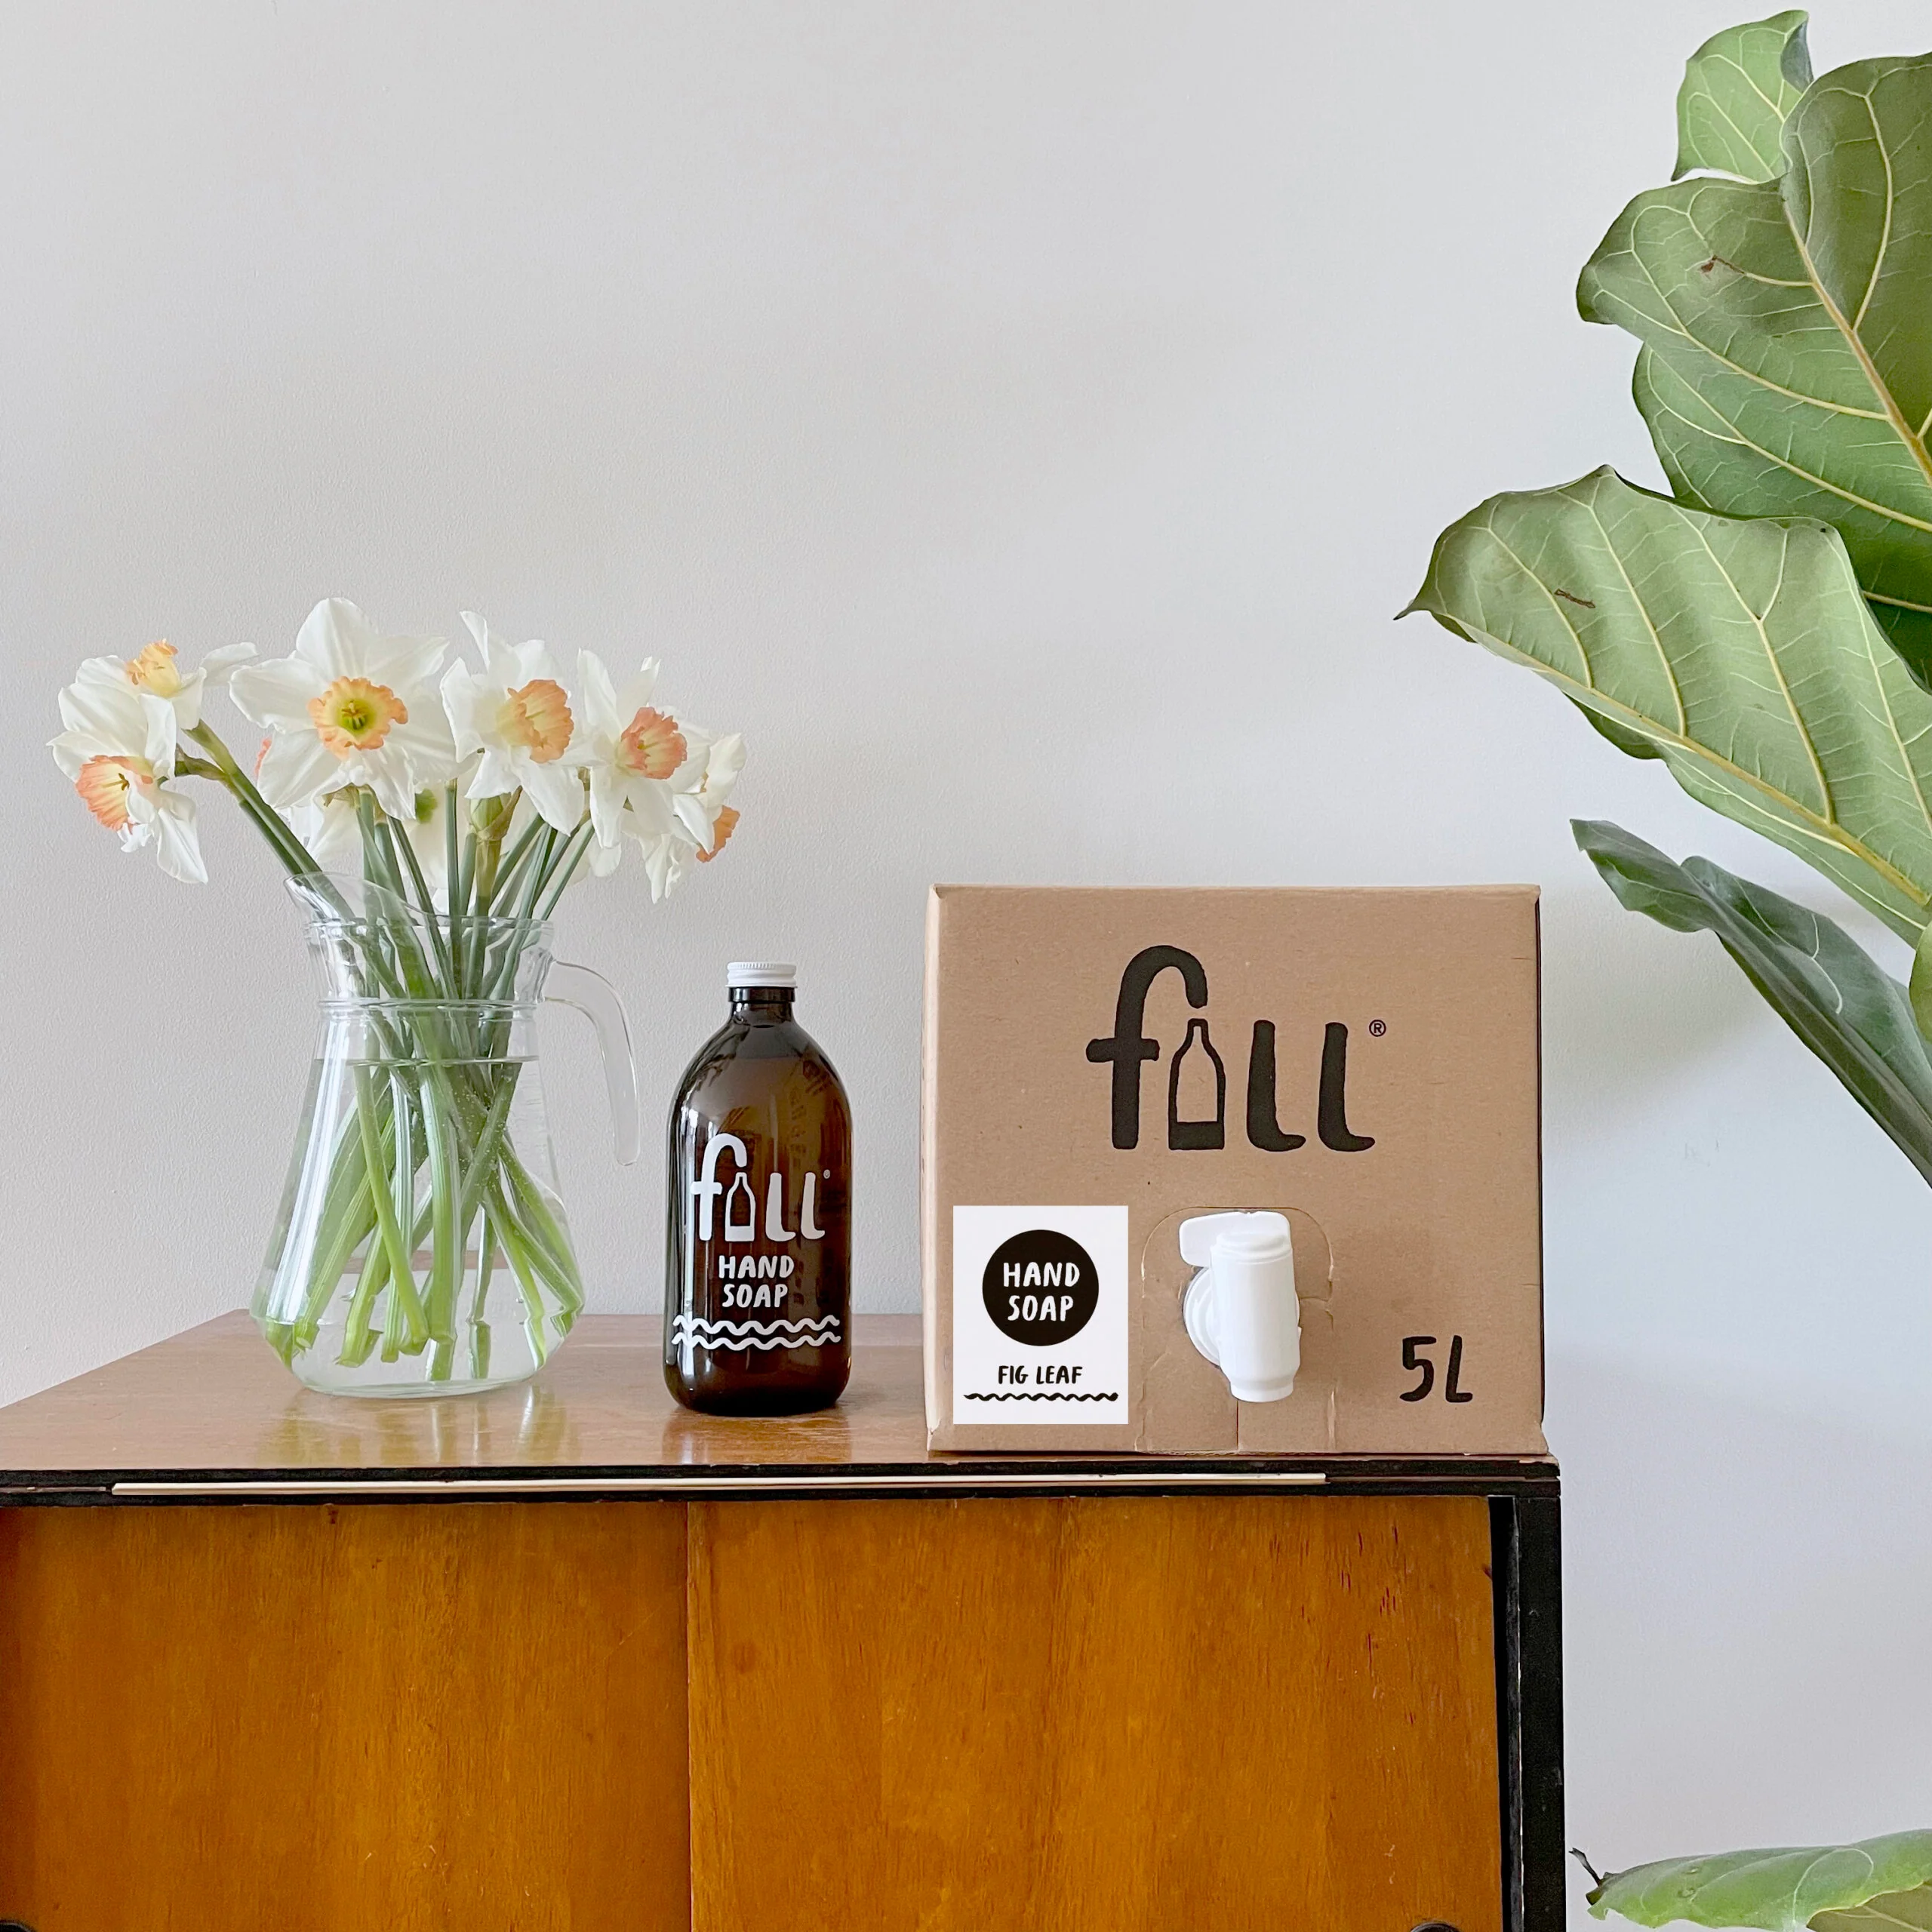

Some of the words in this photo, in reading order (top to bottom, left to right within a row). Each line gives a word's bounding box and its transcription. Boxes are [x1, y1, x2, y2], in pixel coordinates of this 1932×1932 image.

[718, 1255, 795, 1279] HAND
[1003, 1262, 1081, 1288] HAND
[722, 1284, 789, 1308] SOAP
[1008, 1294, 1074, 1322] SOAP
[997, 1364, 1029, 1386] FIG
[1035, 1364, 1083, 1386] LEAF
[1400, 1334, 1473, 1403] 5L
